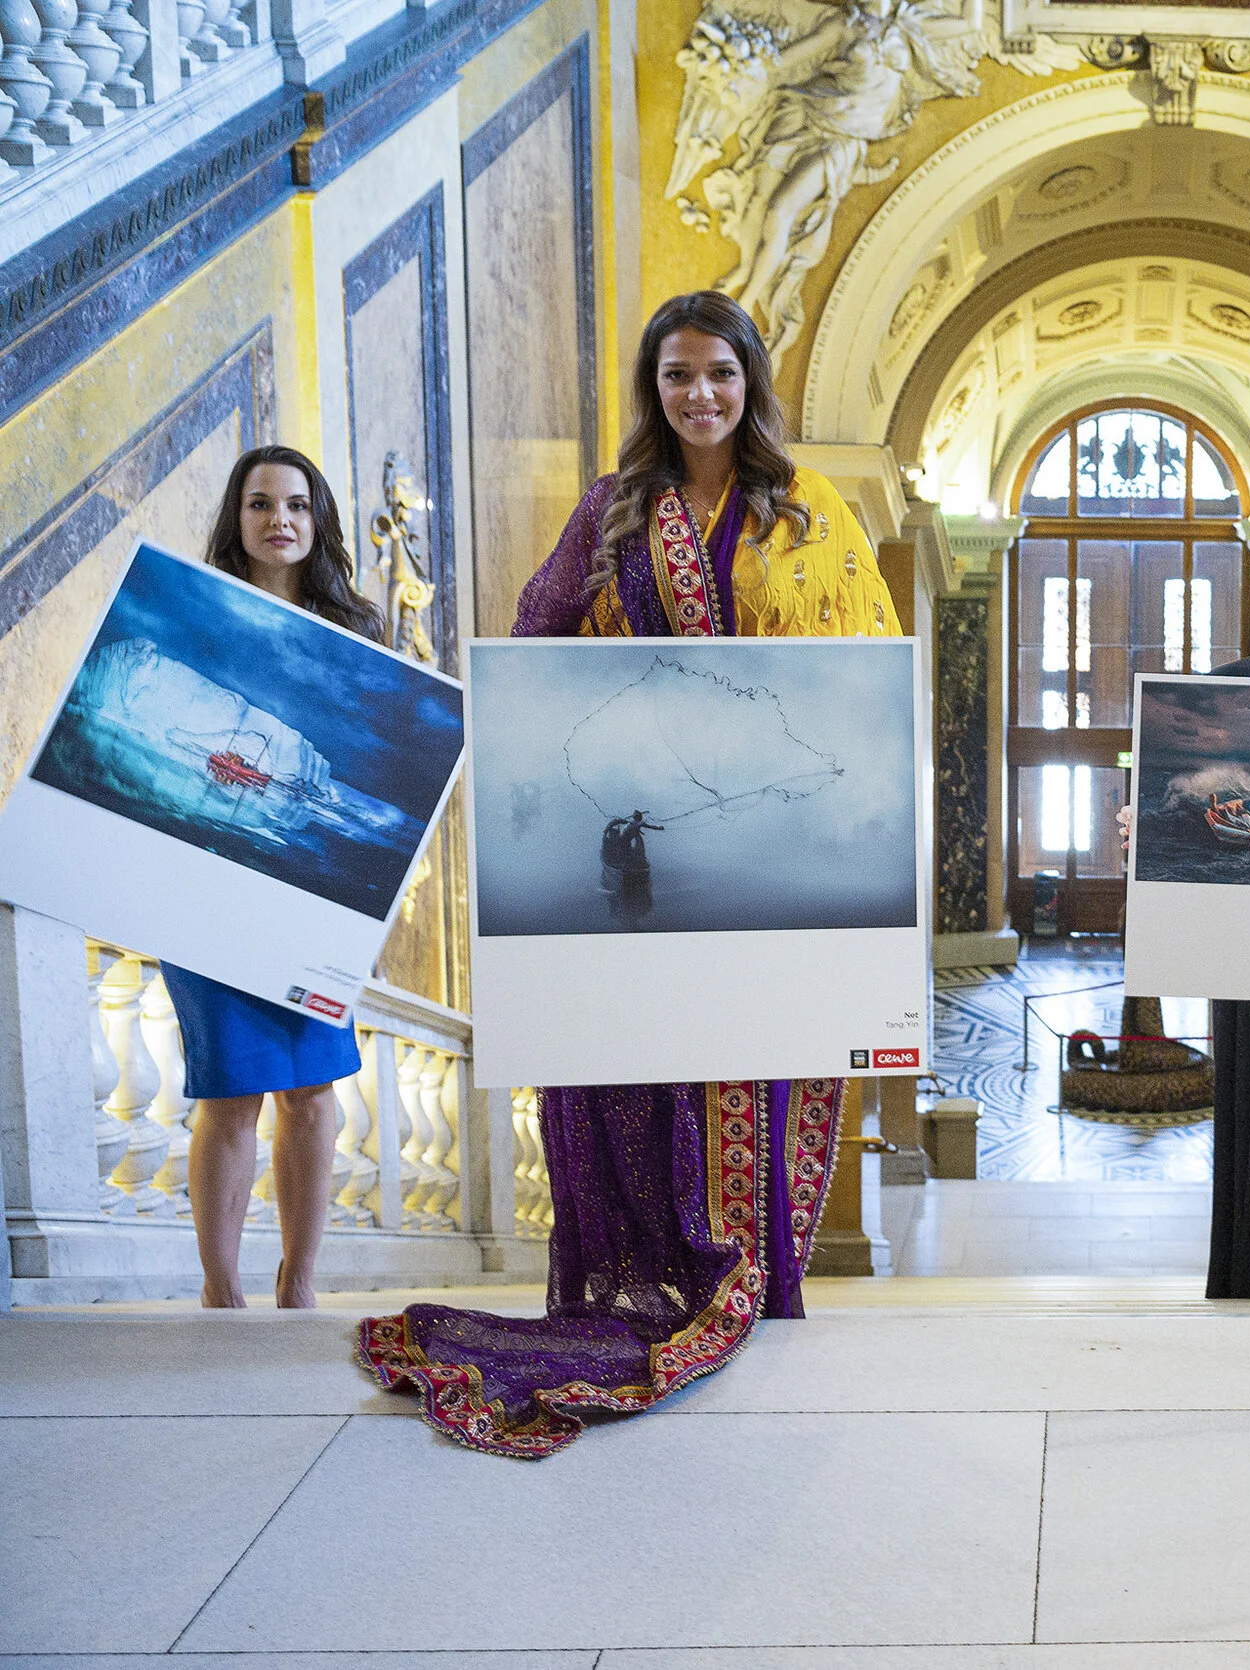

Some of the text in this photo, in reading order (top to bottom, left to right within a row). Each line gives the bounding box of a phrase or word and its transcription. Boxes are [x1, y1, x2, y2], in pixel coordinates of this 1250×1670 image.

[885, 1020, 919, 1029] Tang Yin
[877, 1053, 915, 1065] cewe
